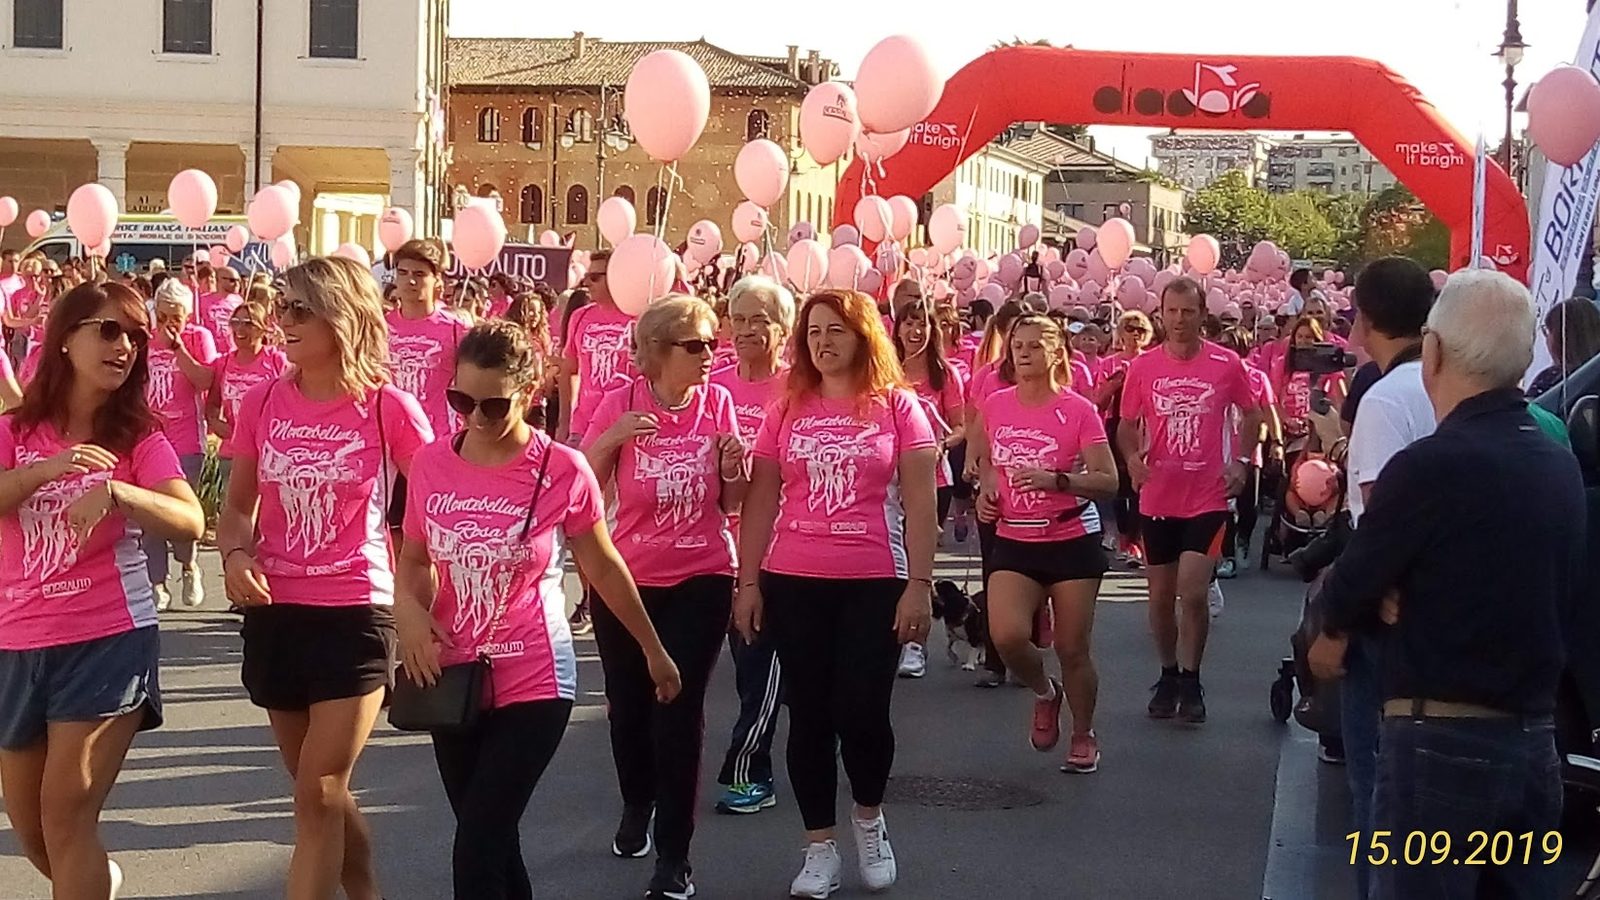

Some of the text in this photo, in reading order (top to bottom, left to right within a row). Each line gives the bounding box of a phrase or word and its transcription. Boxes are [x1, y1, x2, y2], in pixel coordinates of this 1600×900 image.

[911, 122, 941, 134] ake
[1395, 142, 1438, 154] make
[1420, 152, 1464, 169] bright
[114, 224, 140, 232] ROCE
[453, 520, 504, 540] Rosa
